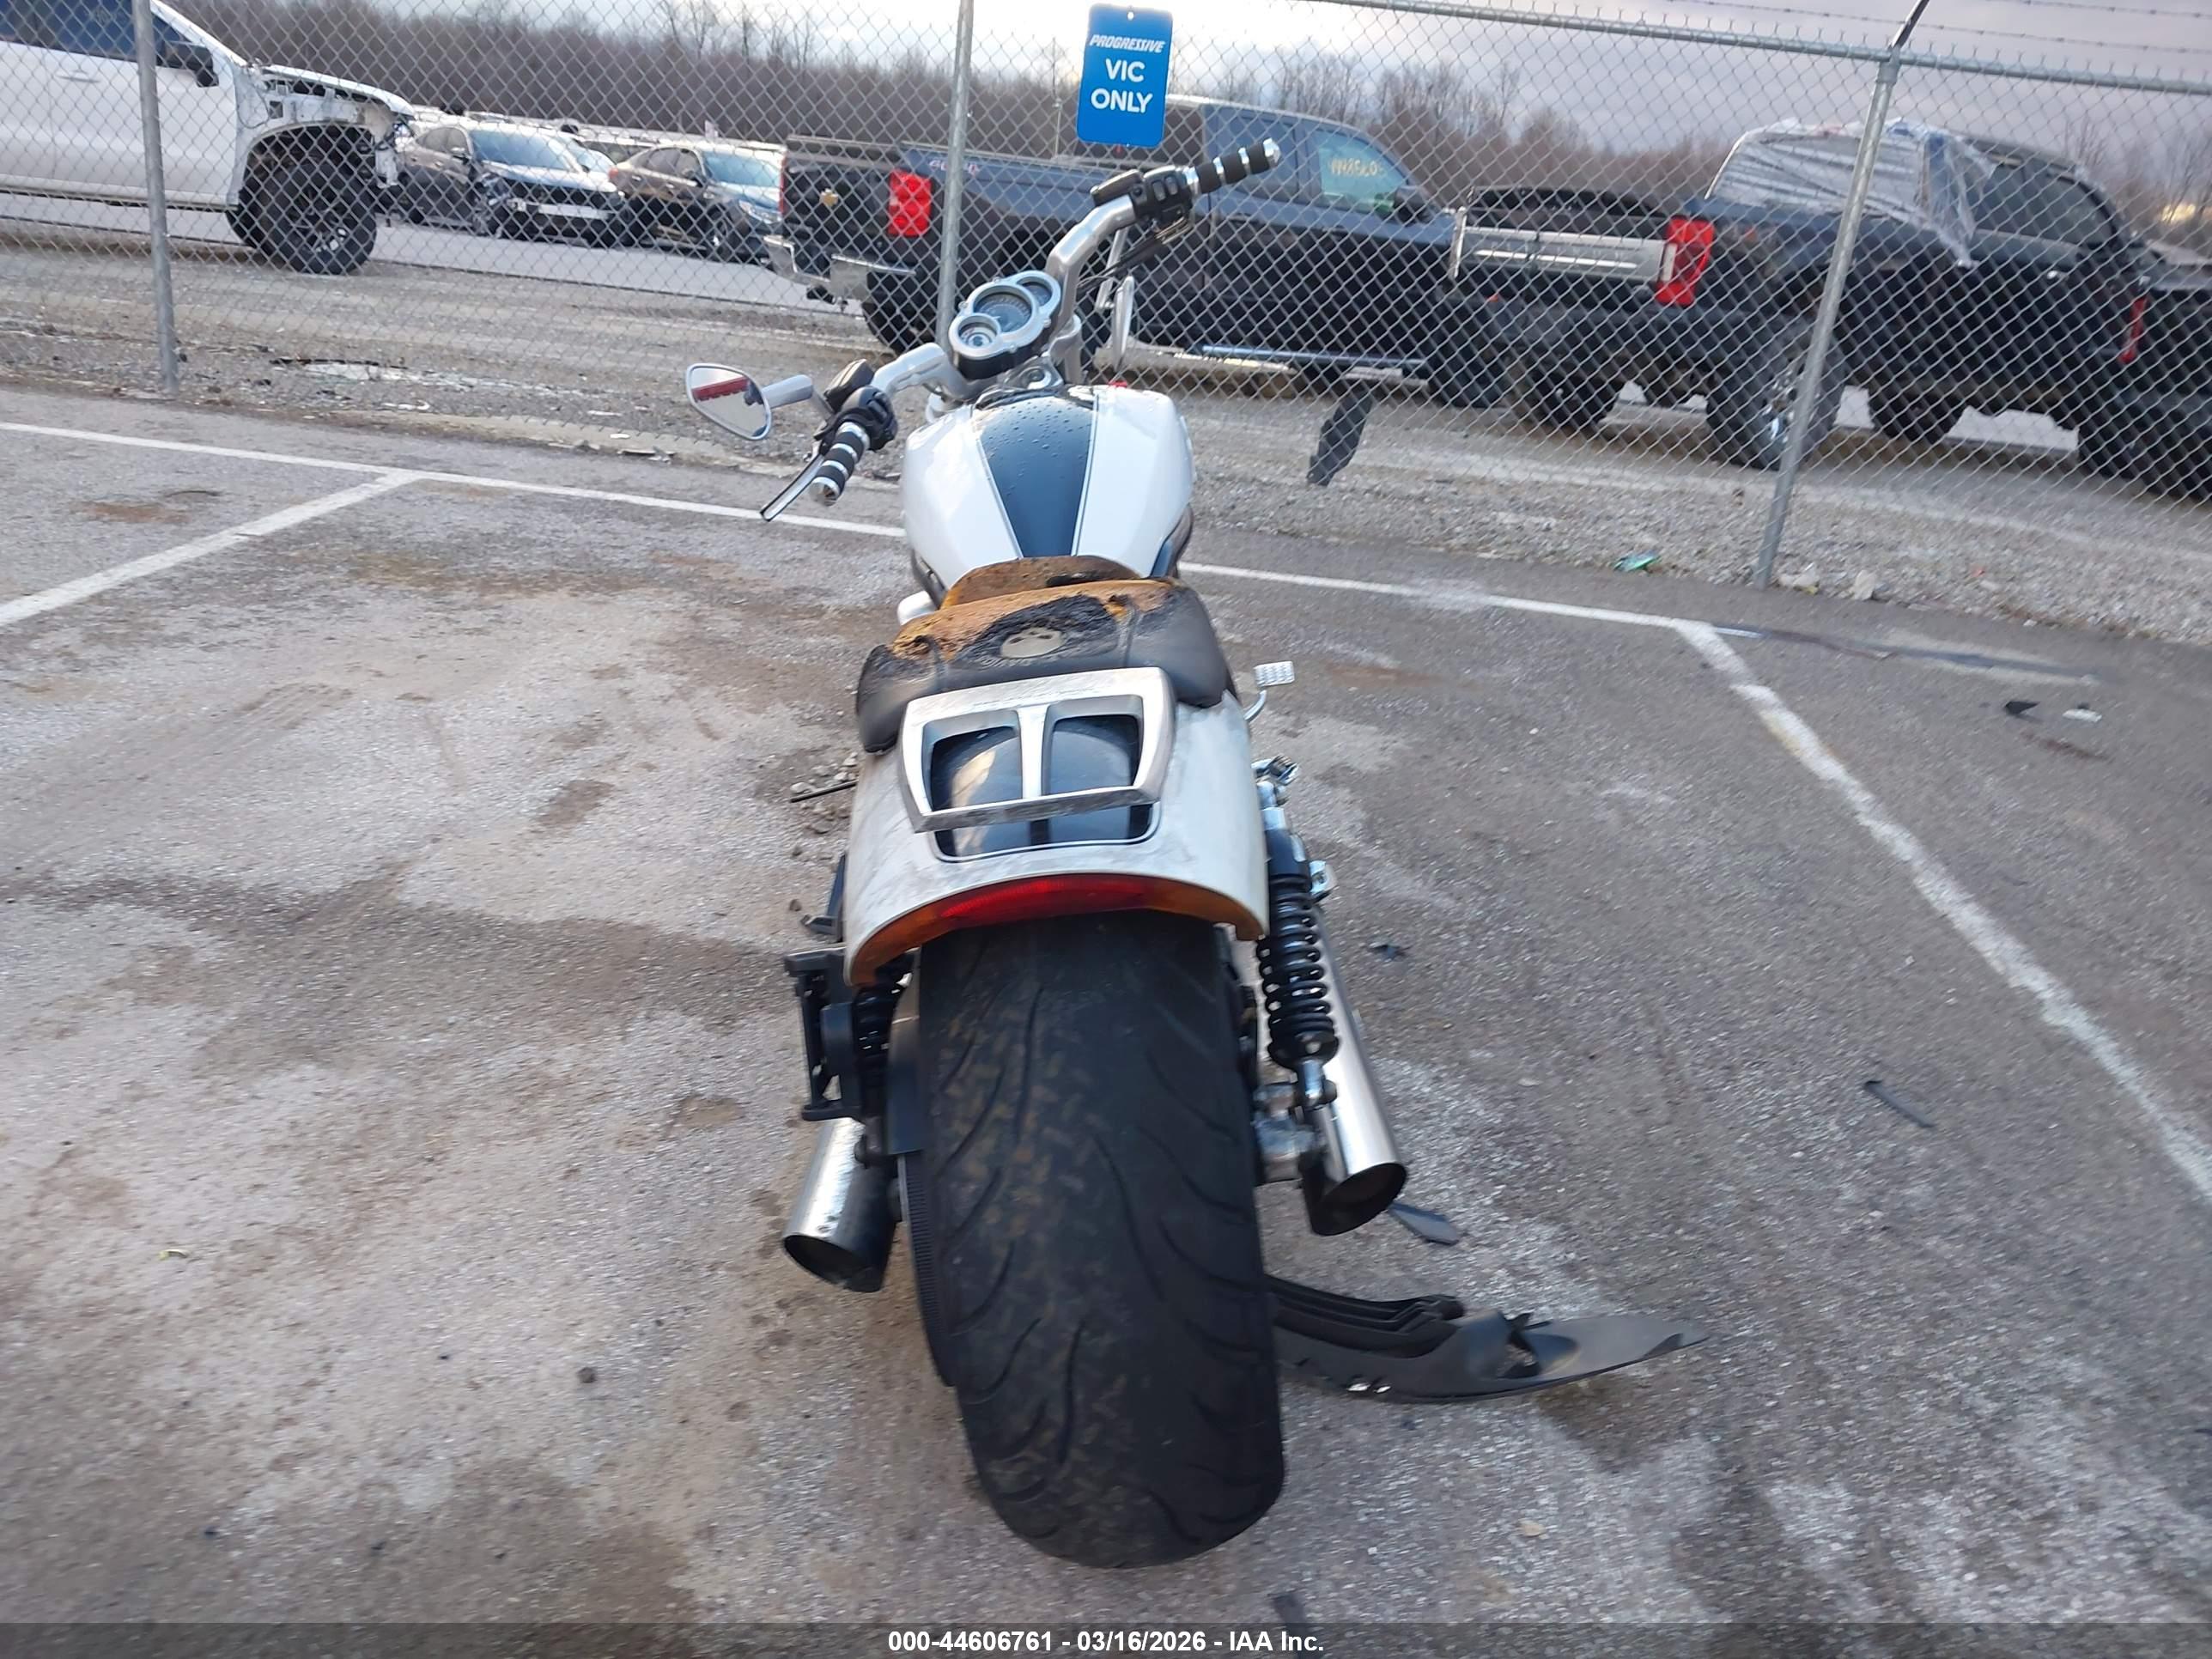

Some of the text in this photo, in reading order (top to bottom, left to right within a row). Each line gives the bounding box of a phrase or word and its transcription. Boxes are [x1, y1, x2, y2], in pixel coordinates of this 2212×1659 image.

[1089, 34, 1166, 53] PROGRESSIVE
[1105, 58, 1146, 82] VIC
[1091, 88, 1153, 113] ONLY
